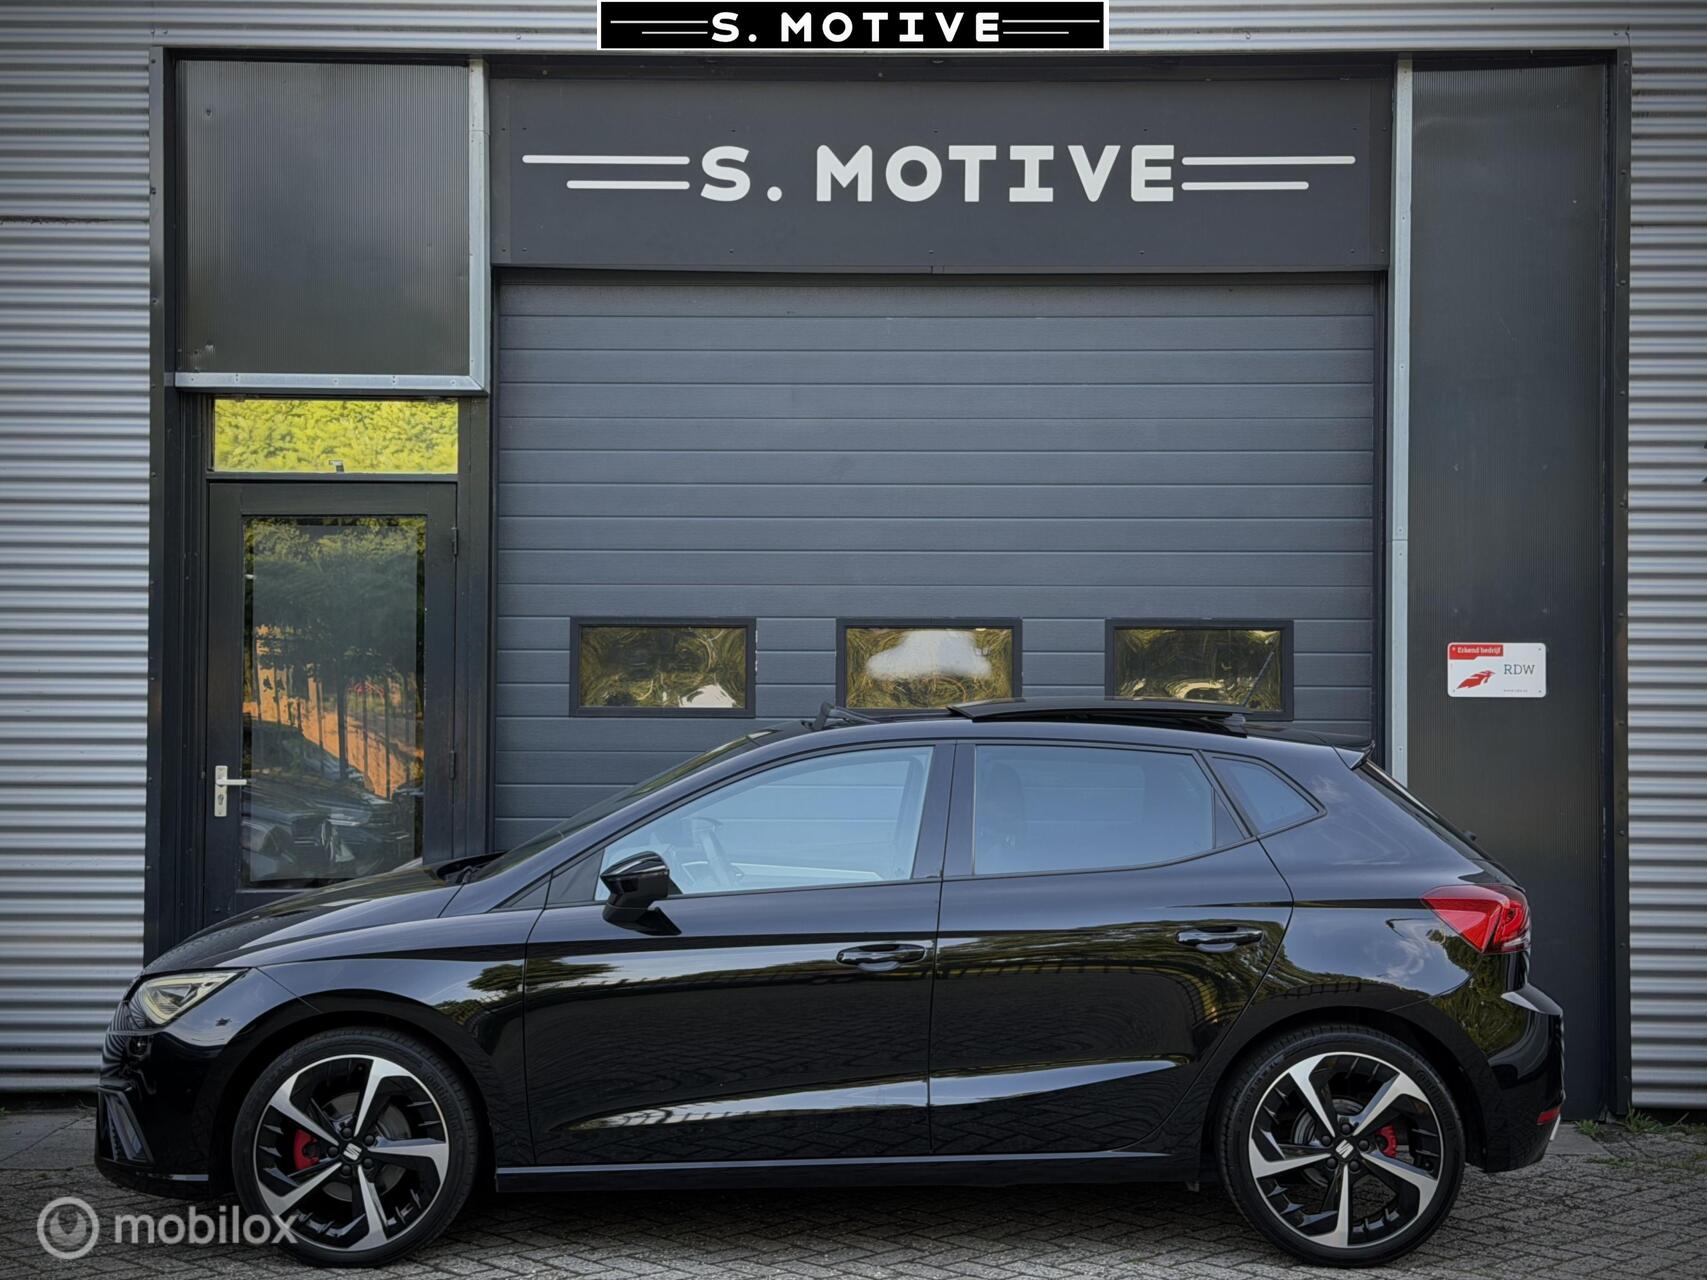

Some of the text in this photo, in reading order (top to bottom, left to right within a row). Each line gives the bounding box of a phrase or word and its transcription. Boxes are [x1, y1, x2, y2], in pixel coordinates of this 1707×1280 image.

[700, 145, 1175, 202] S. MOTIVE
[1503, 664, 1536, 675] RDW
